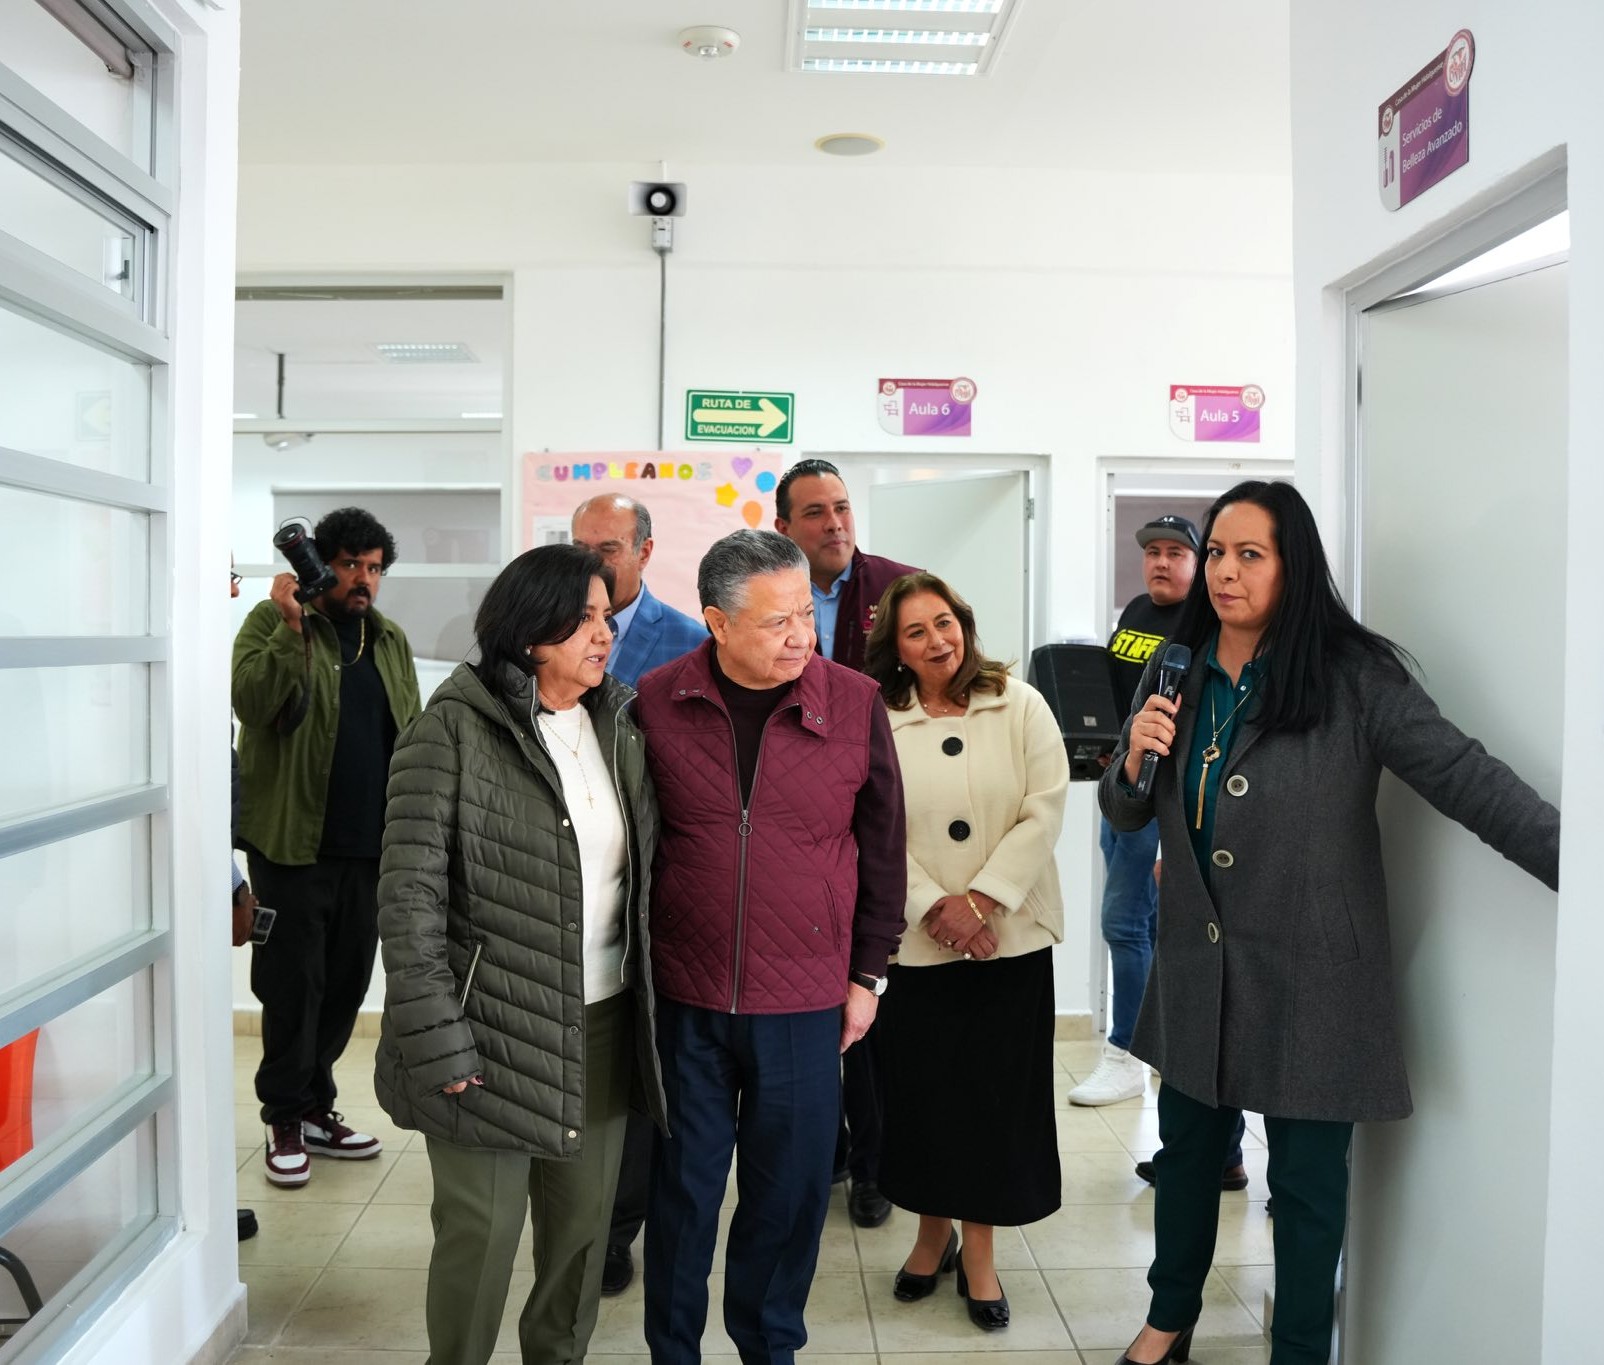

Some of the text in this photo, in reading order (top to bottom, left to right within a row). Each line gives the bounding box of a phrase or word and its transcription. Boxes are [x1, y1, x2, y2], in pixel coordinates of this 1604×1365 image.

[1402, 107, 1443, 147] Servicios de
[1402, 120, 1463, 174] Belleza Avanzado
[702, 398, 751, 409] RUTA DE
[909, 402, 951, 416] Aula 6
[1200, 409, 1240, 423] Aula 5
[697, 424, 756, 435] EVACUACION
